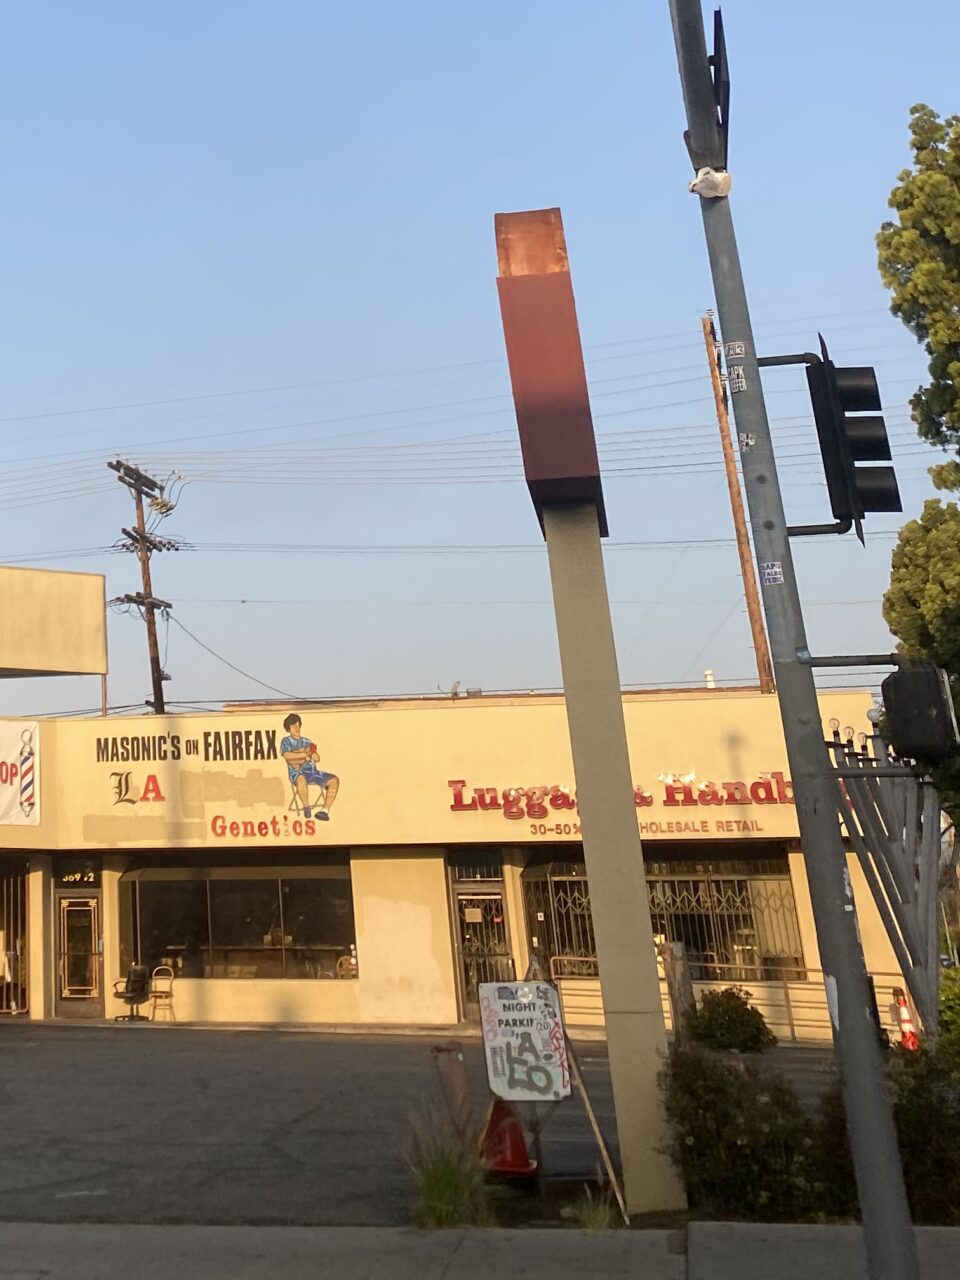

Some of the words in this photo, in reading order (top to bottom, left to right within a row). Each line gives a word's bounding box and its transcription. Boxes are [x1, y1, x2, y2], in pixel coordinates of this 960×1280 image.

[96, 731, 181, 762] MASONIC'S
[203, 730, 278, 761] FAIRFAX
[448, 780, 582, 820] Lugga
[211, 815, 316, 838] Genetics
[640, 821, 709, 834] HOLESALE
[716, 820, 764, 833] RETAIL
[502, 1002, 537, 1013] NIGHT
[497, 1017, 534, 1028] PARKI
